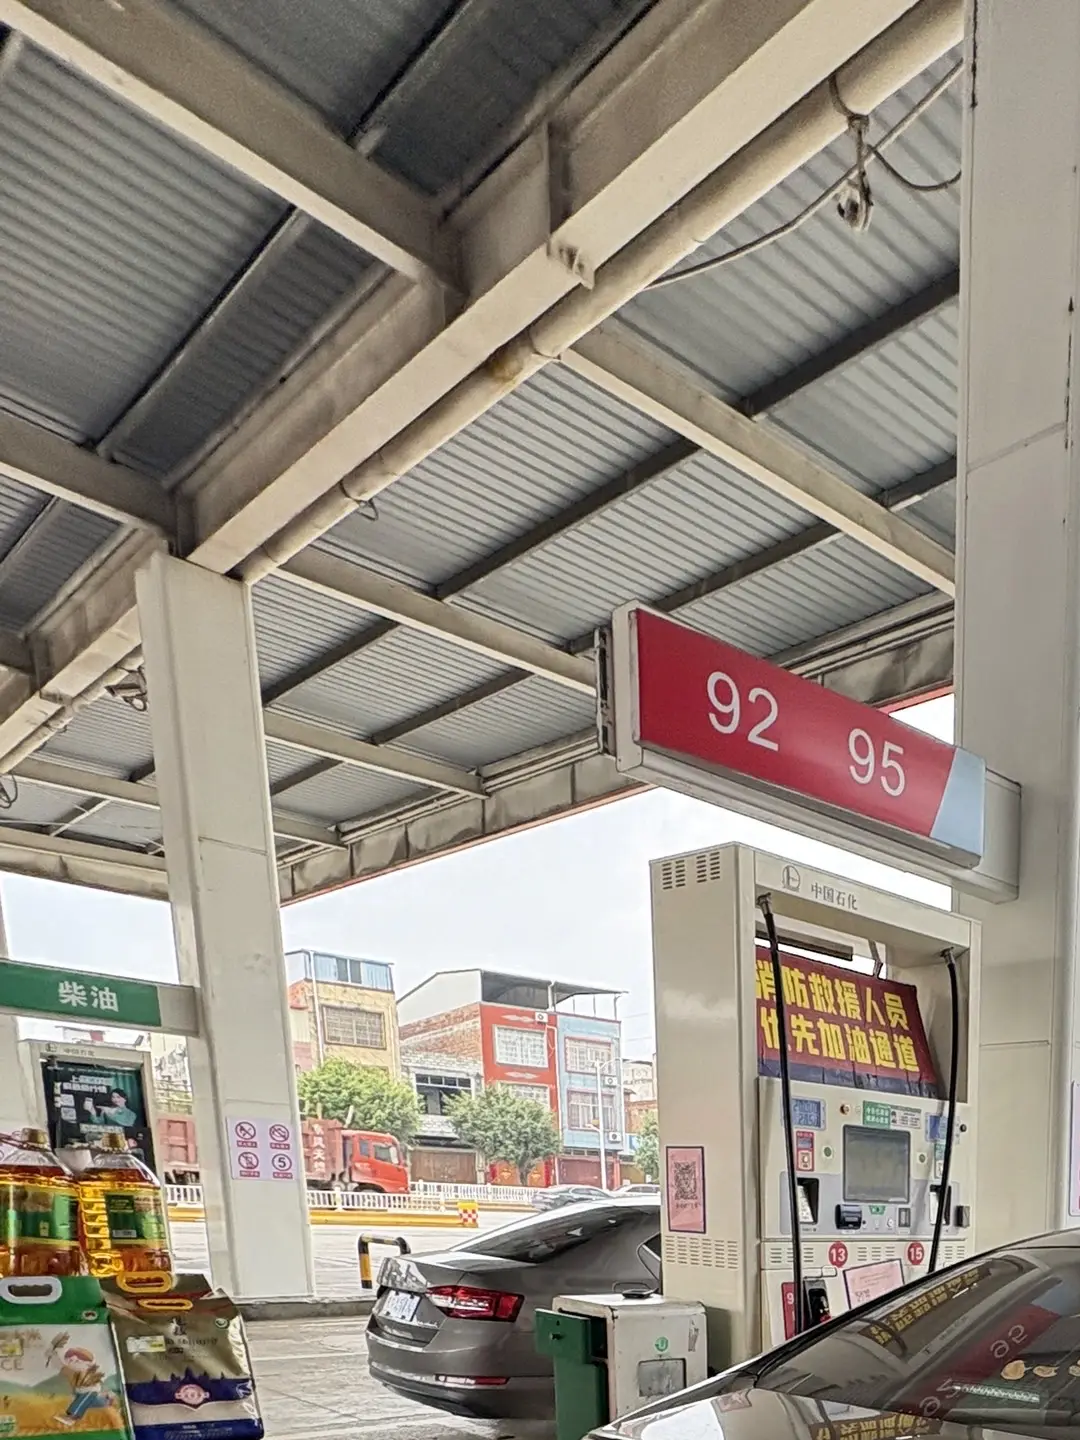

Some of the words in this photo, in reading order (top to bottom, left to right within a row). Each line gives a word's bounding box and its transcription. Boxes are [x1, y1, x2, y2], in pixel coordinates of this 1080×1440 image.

[706, 671, 779, 751] 92
[848, 728, 906, 796] 95
[810, 881, 858, 911] 中国石化
[58, 980, 119, 1013] 柴油
[756, 959, 910, 1031] 消防救援人员
[759, 1006, 920, 1073] 优先加油通道
[278, 1158, 286, 1169] 5
[829, 1247, 847, 1264] 13
[908, 1246, 923, 1262] 15
